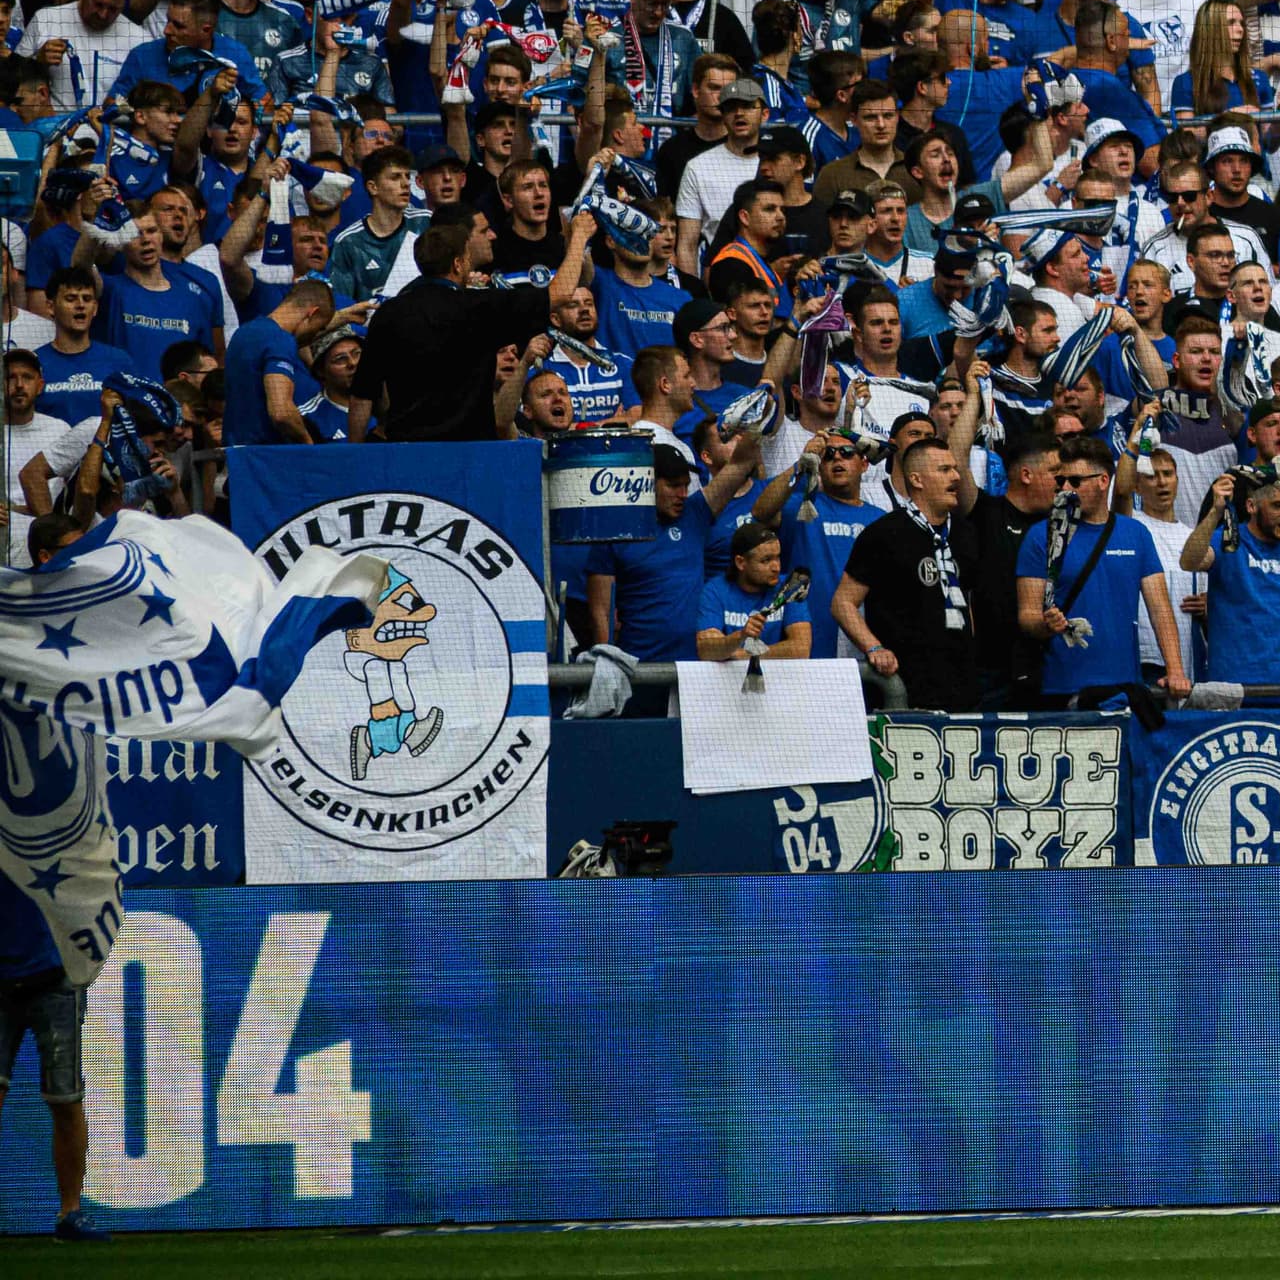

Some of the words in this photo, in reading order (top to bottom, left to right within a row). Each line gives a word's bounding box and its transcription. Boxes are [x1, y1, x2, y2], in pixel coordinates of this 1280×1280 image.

[45, 381, 103, 393] NORDKUR
[571, 394, 620, 411] CTORIA
[262, 499, 515, 582] ULTRAS
[884, 723, 1124, 809] BLUE
[889, 806, 1120, 872] BOYZ
[80, 910, 373, 1210] 04
